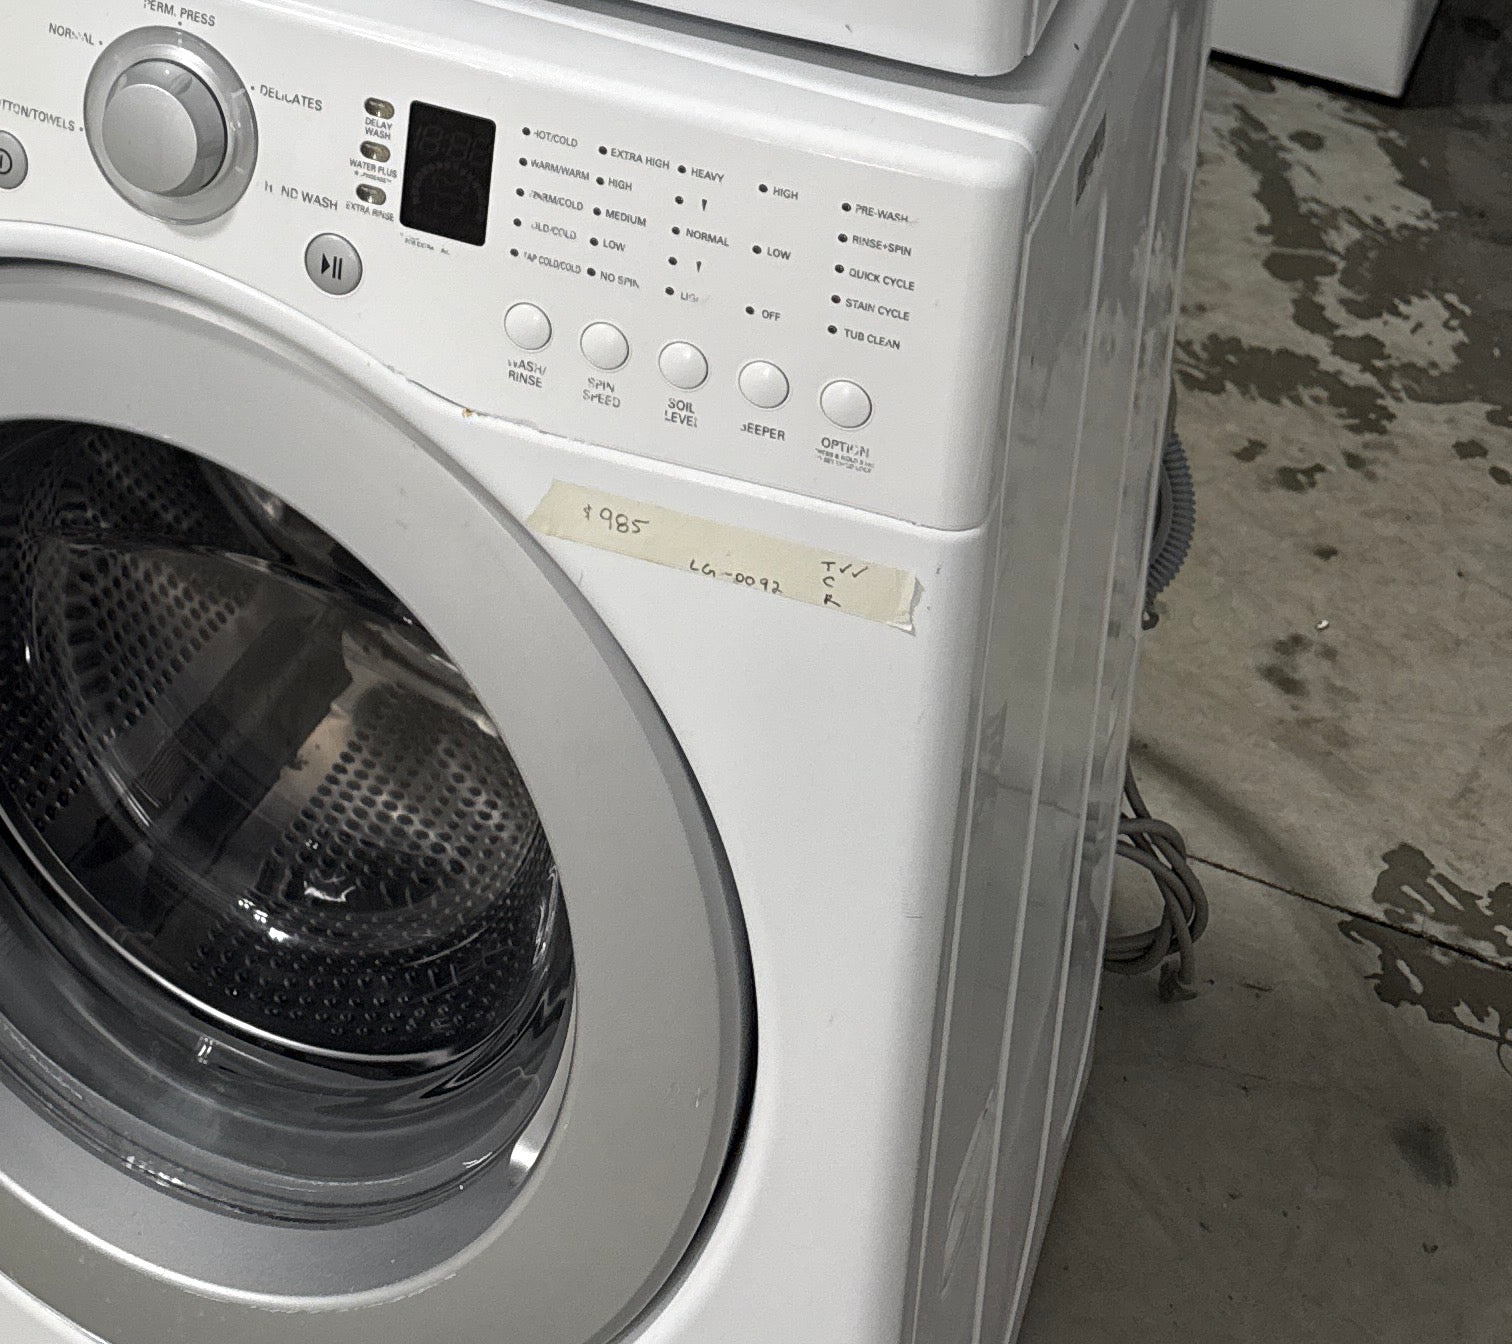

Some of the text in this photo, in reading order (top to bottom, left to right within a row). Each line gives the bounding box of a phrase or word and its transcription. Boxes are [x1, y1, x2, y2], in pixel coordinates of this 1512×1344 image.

[180, 8, 216, 28] PRESS
[48, 22, 94, 46] NORAL
[365, 117, 392, 130] DELAY
[365, 127, 391, 140] WASH
[350, 158, 376, 172] WATER
[611, 148, 670, 171] EXTRA HIGH
[608, 177, 632, 191] HIGH
[691, 167, 724, 183] HEAVY
[265, 180, 338, 211] HND WASH
[773, 186, 799, 200] HIGH
[346, 201, 370, 215] EXTRA
[855, 204, 909, 224] PRE-WASH
[605, 208, 647, 227] MEDIUM
[603, 239, 626, 252] LOW
[686, 227, 730, 248] NORMAL
[852, 233, 912, 256] RINSE+SPIN
[767, 246, 791, 260] LOW
[600, 270, 615, 283] NO
[849, 266, 915, 291] QUICK CYCLE
[762, 308, 781, 322] OFF
[845, 297, 910, 321] STAIN CYCLE
[844, 327, 900, 350] TUB CLEAN
[508, 369, 543, 388] RINSE
[667, 397, 695, 414] SOIL
